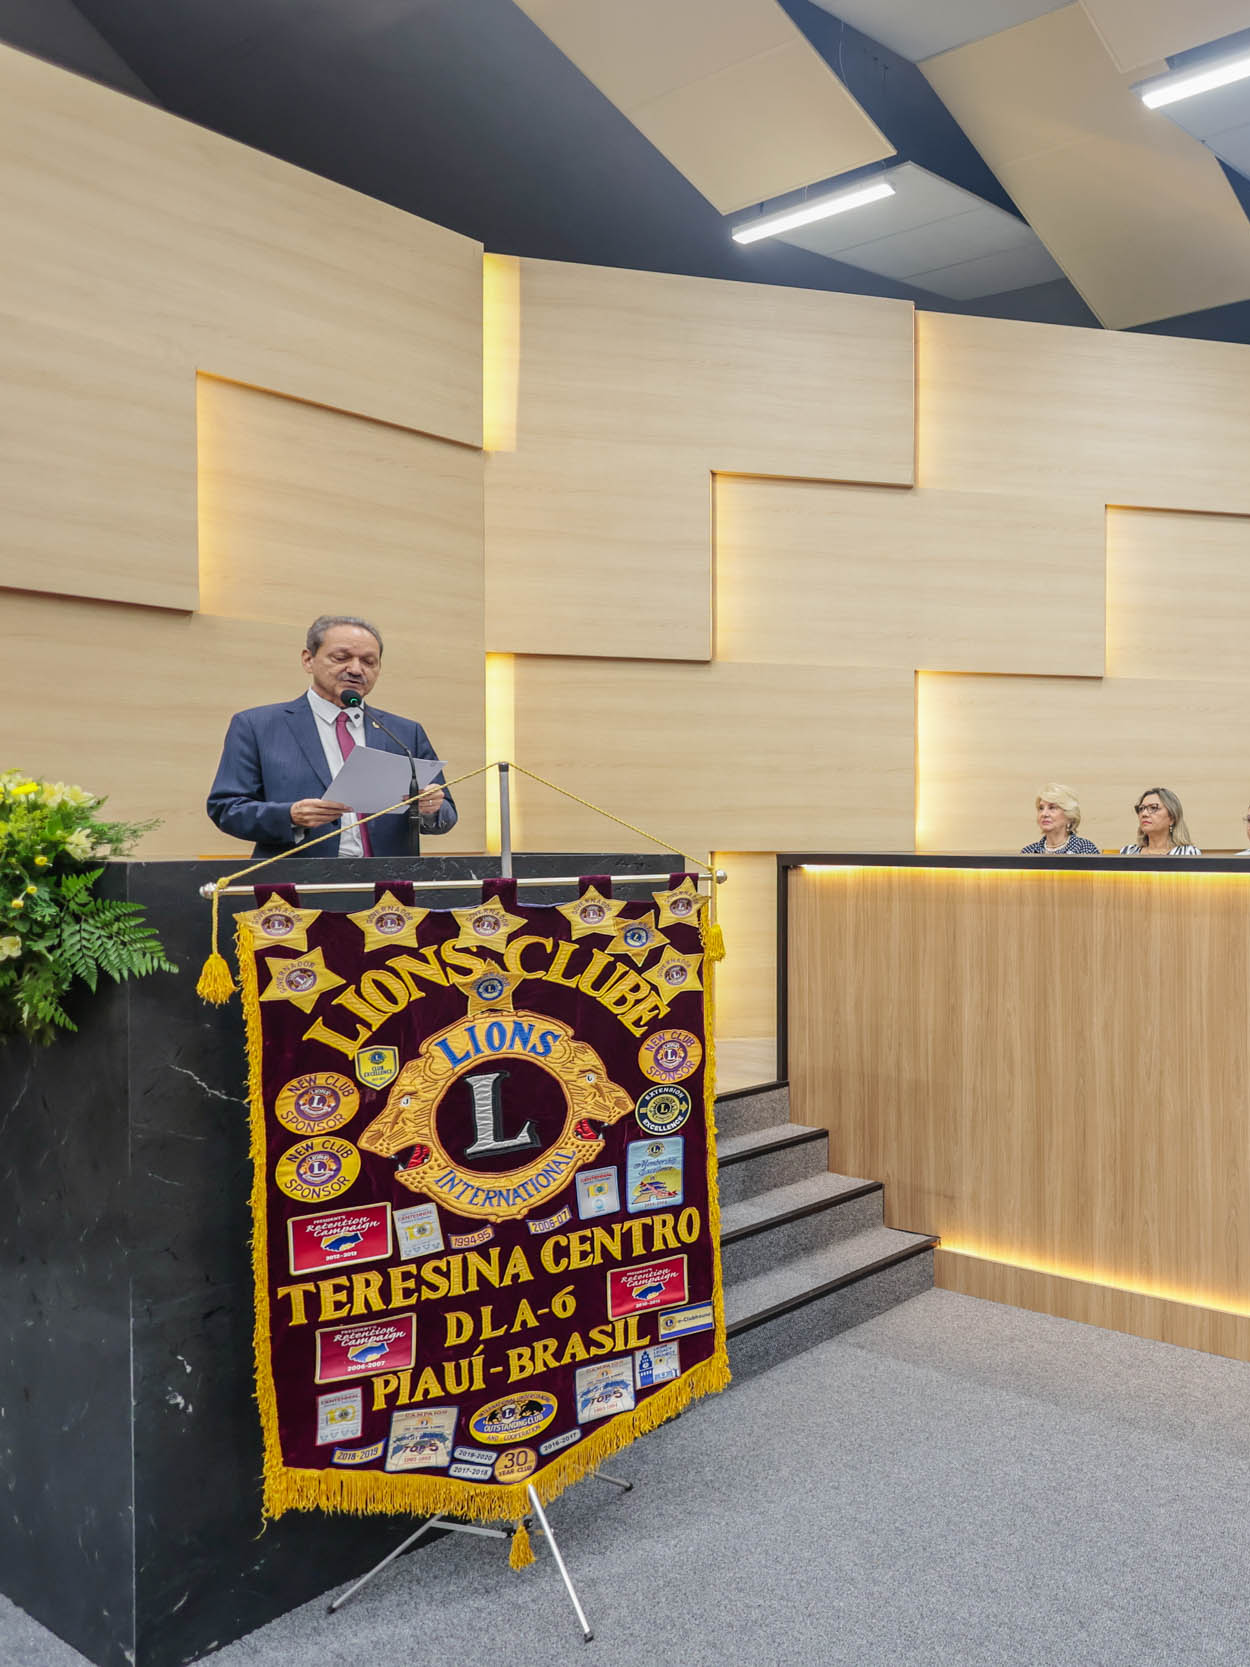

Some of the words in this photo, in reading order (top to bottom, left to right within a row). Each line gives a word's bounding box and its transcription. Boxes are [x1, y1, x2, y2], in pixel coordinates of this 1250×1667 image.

[302, 939, 483, 1061] LIONS
[503, 935, 672, 1039] CLUBE
[434, 1019, 561, 1069] LIONS
[644, 1033, 665, 1052] NEW
[671, 1031, 696, 1047] CLUB
[667, 1051, 675, 1060] L
[646, 1060, 695, 1081] SPONSOR
[287, 1075, 317, 1095] NEW
[325, 1075, 354, 1097] CLUB
[645, 1087, 685, 1100] EXTENSION
[312, 1096, 323, 1108] L
[281, 1110, 346, 1133] SPONSOR
[464, 1072, 540, 1158] L
[642, 1115, 684, 1131] EXCELLENCE
[286, 1142, 314, 1163] NEW
[322, 1140, 354, 1159] CLUB
[313, 1162, 324, 1174] L
[284, 1175, 350, 1199] SPONSOR
[433, 1148, 577, 1209] INTERNATIONAL
[306, 1217, 370, 1233] Retention
[314, 1220, 380, 1237] Campaign
[532, 1210, 568, 1232] 2006-07
[454, 1230, 491, 1247] 1994-95
[277, 1244, 535, 1327] TERESINA
[541, 1206, 701, 1275] CENTRO
[621, 1268, 670, 1283] Retention
[627, 1272, 679, 1287] Campaign
[333, 1327, 396, 1342] Retention
[341, 1331, 406, 1346] Campaign
[484, 1418, 527, 1432] OUTSTANDING
[337, 1447, 378, 1460] 2018-2019
[503, 1450, 528, 1469] 30
